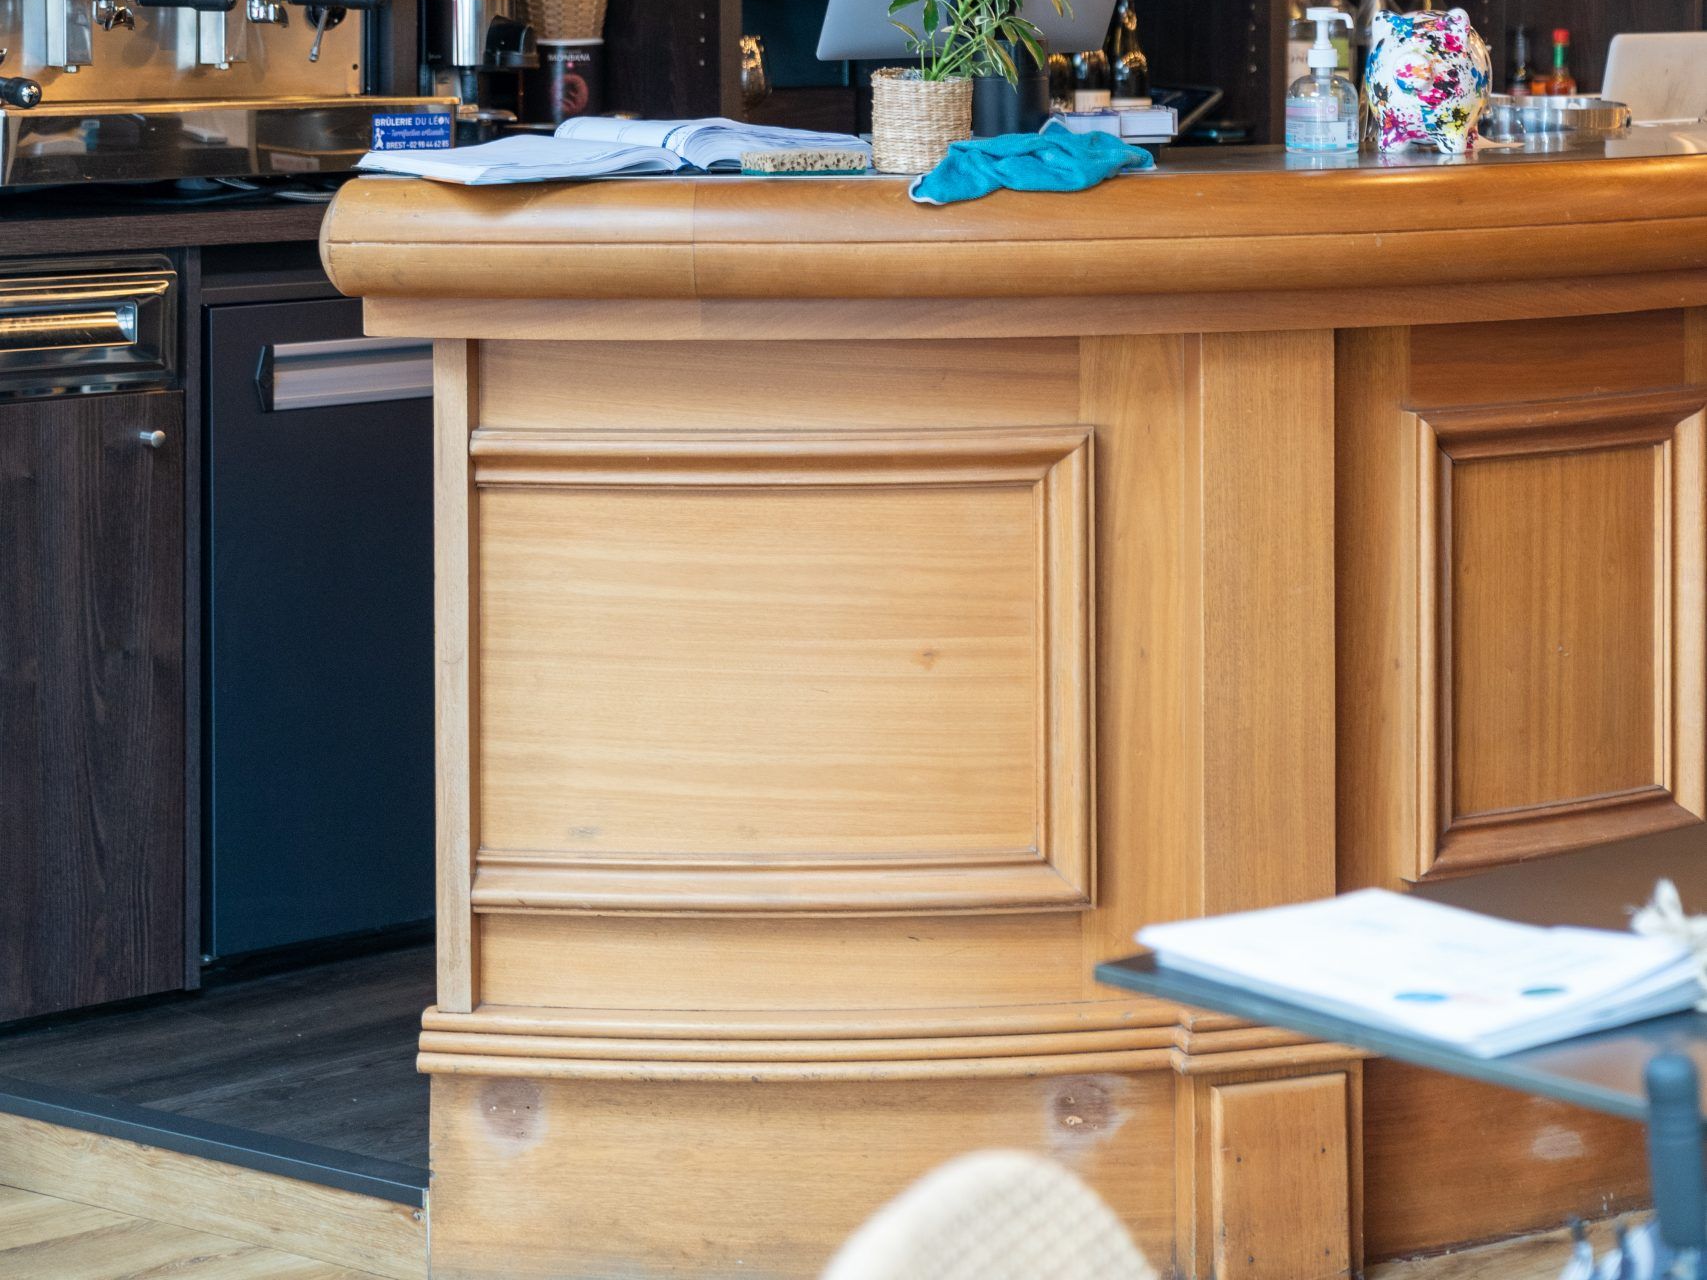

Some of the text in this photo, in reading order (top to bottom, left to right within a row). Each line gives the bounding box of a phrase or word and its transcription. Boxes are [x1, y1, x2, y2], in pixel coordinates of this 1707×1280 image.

[375, 115, 450, 126] BRÛLERIE DU LÉON
